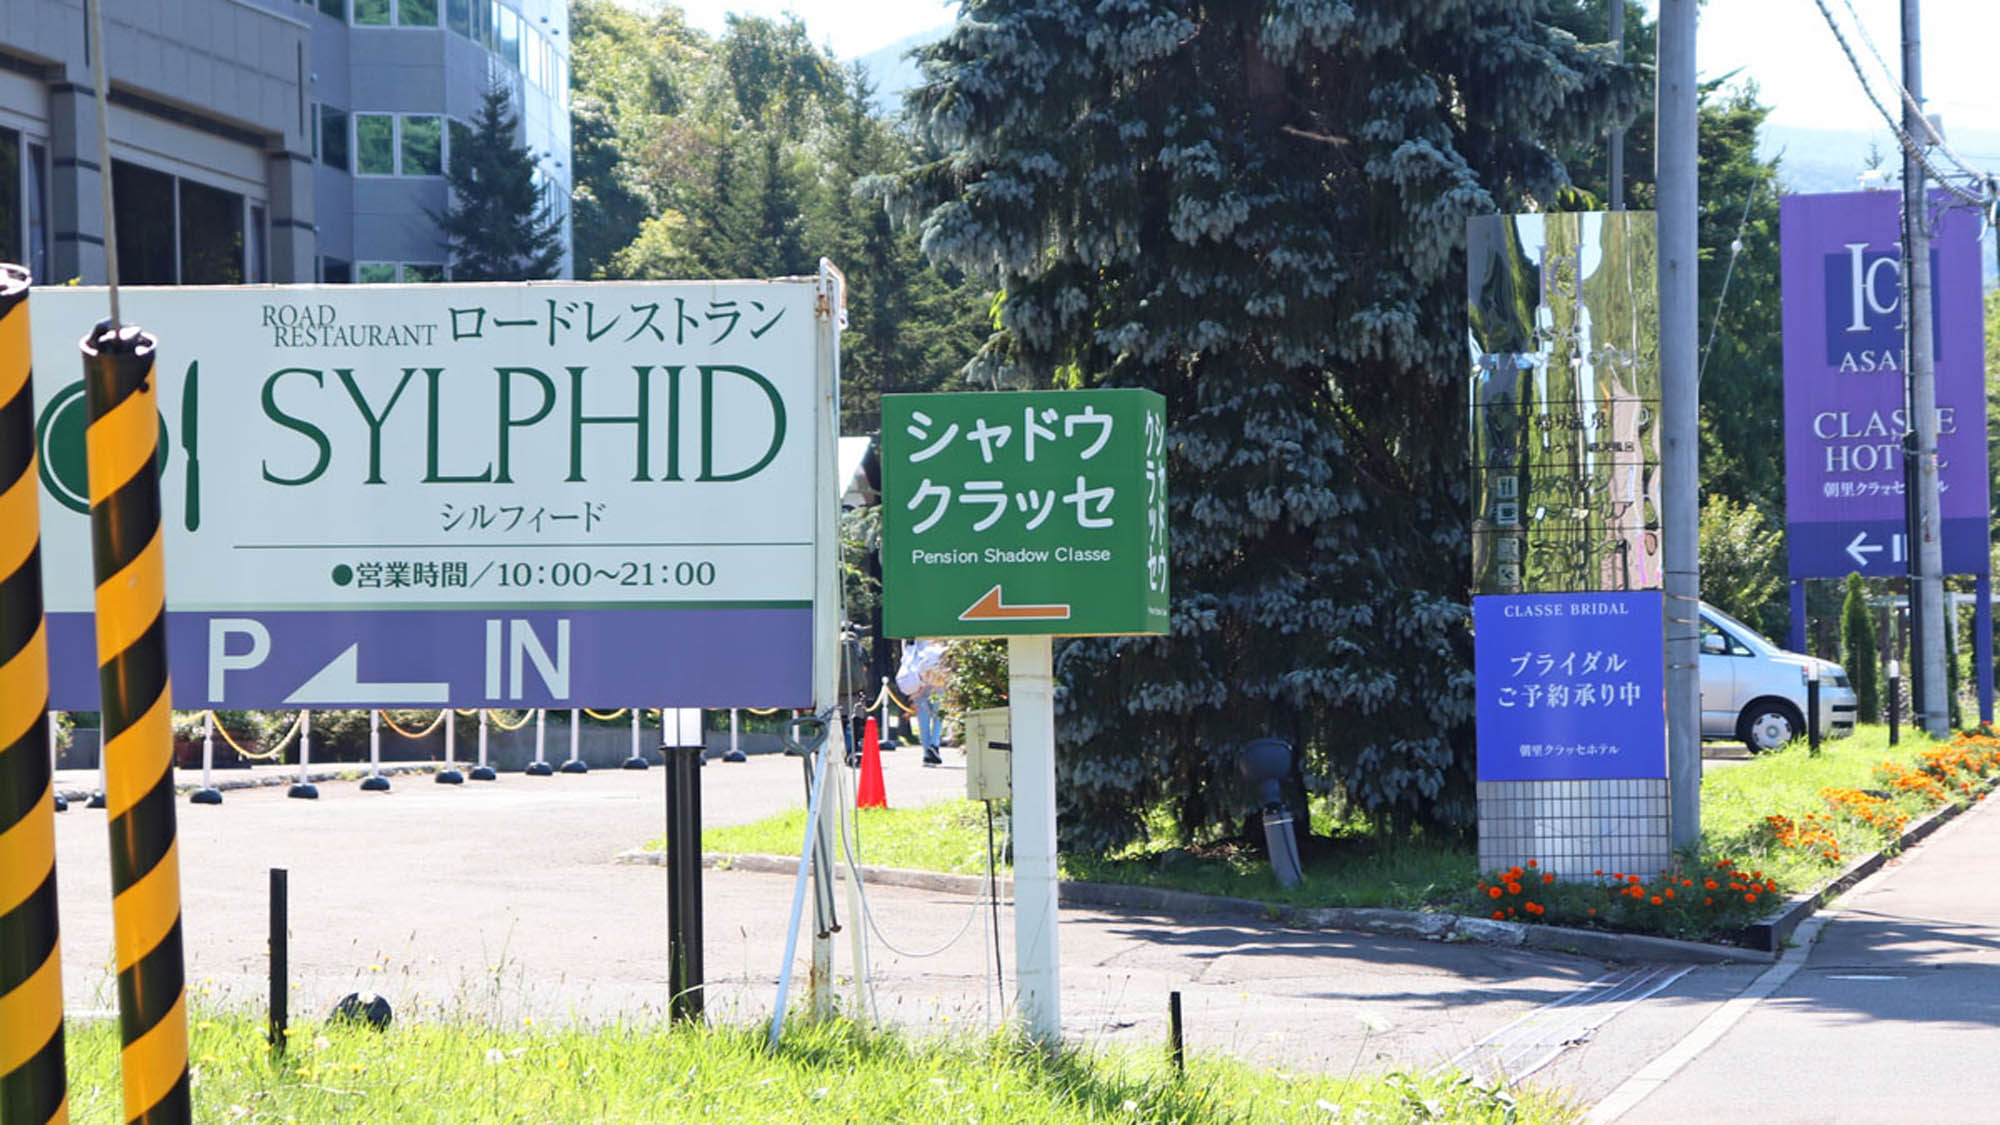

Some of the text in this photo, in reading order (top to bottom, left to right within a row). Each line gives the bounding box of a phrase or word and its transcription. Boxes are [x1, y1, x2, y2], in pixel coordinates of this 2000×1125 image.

[262, 304, 337, 327] ROAD
[448, 297, 787, 346] ロードレストラン
[274, 323, 439, 348] RESTAURANT
[1839, 349, 1905, 374] ASA
[261, 365, 788, 486] SYLPHID
[907, 405, 1114, 463] シャドウ
[1813, 407, 1957, 440] CLASE
[1825, 444, 1949, 473] HOT
[1823, 480, 1949, 498] 朝里クラッセル
[440, 501, 606, 533] シルフィード
[907, 475, 1115, 534] クラッセ
[912, 547, 1111, 564] Pension Shadow Classe
[1504, 602, 1629, 618] CLASSE BRIDAL
[208, 618, 571, 703] P IN
[1510, 651, 1628, 678] ブライダル
[1498, 681, 1641, 709] ご予約承り中
